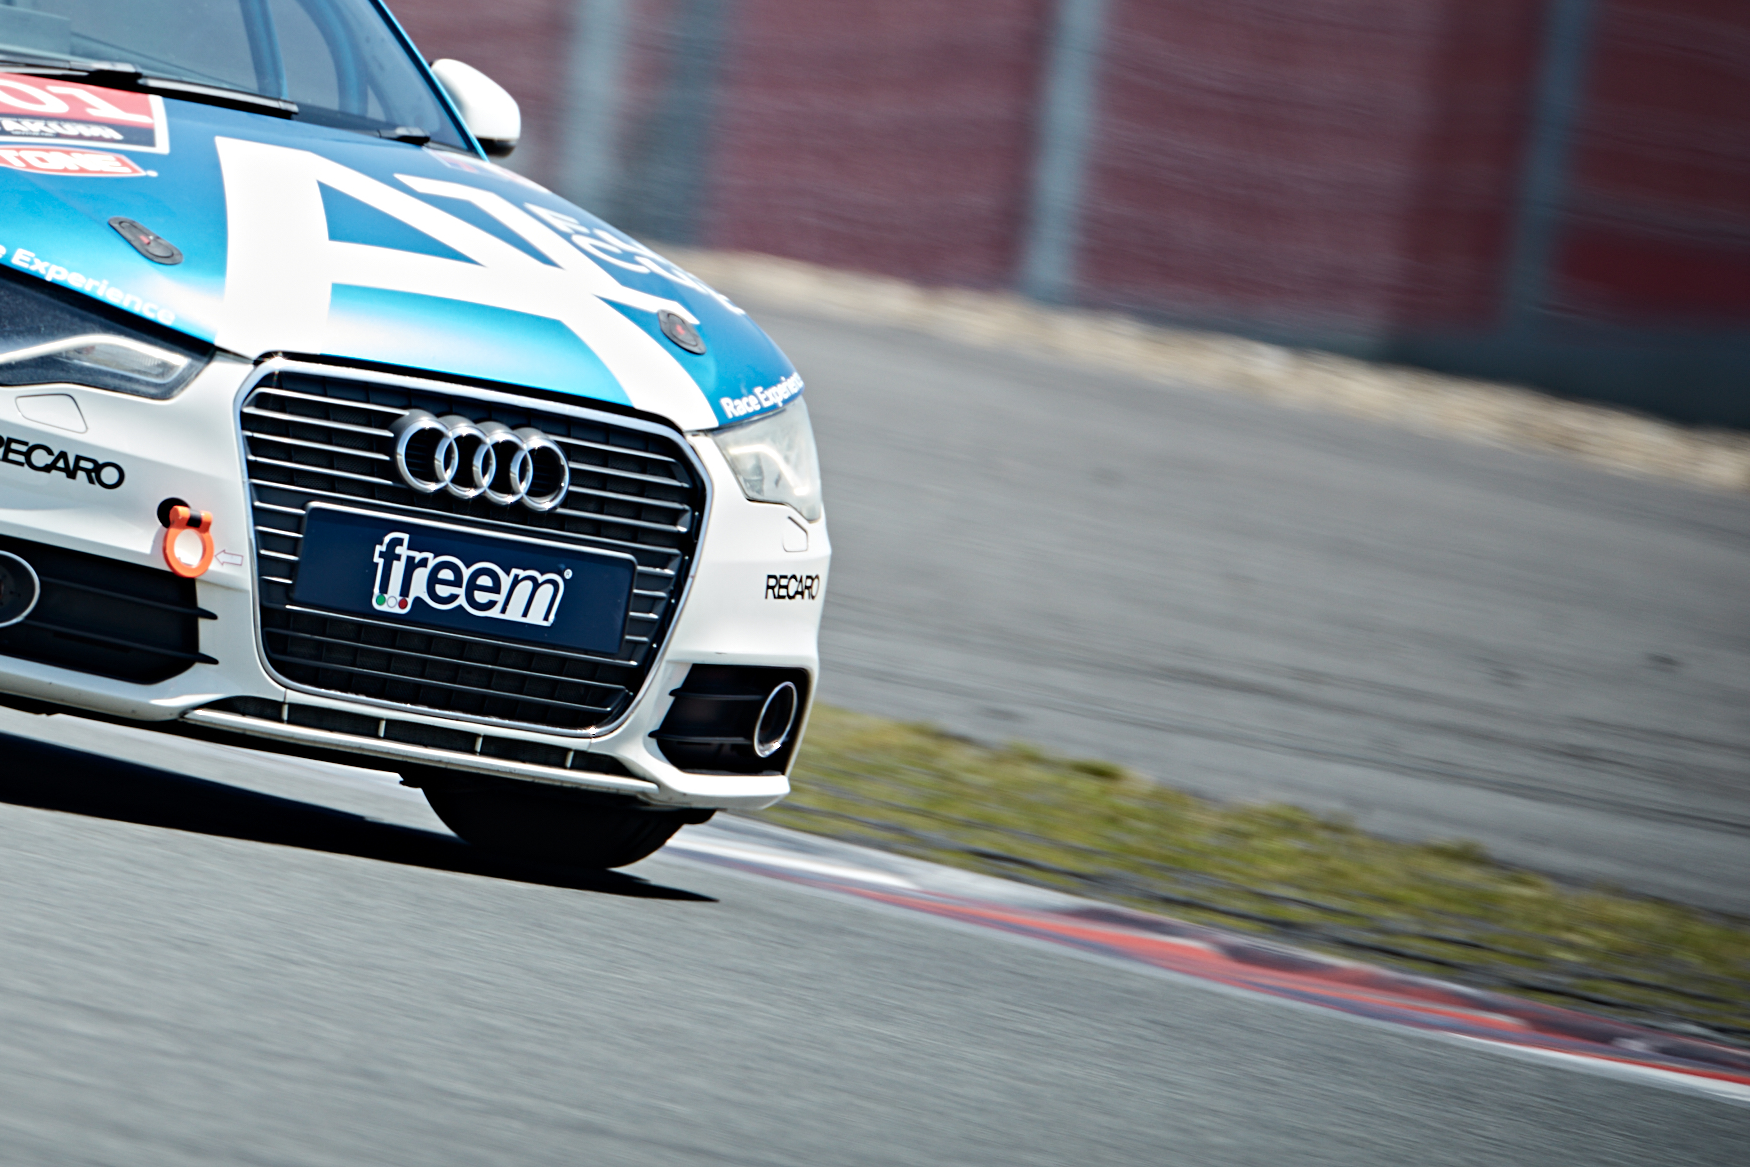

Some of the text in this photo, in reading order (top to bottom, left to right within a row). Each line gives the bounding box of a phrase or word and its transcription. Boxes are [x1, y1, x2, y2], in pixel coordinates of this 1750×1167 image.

[10, 246, 178, 328] Experience
[719, 394, 761, 420] Race
[373, 532, 564, 626] freem
[765, 573, 820, 601] RECARO
